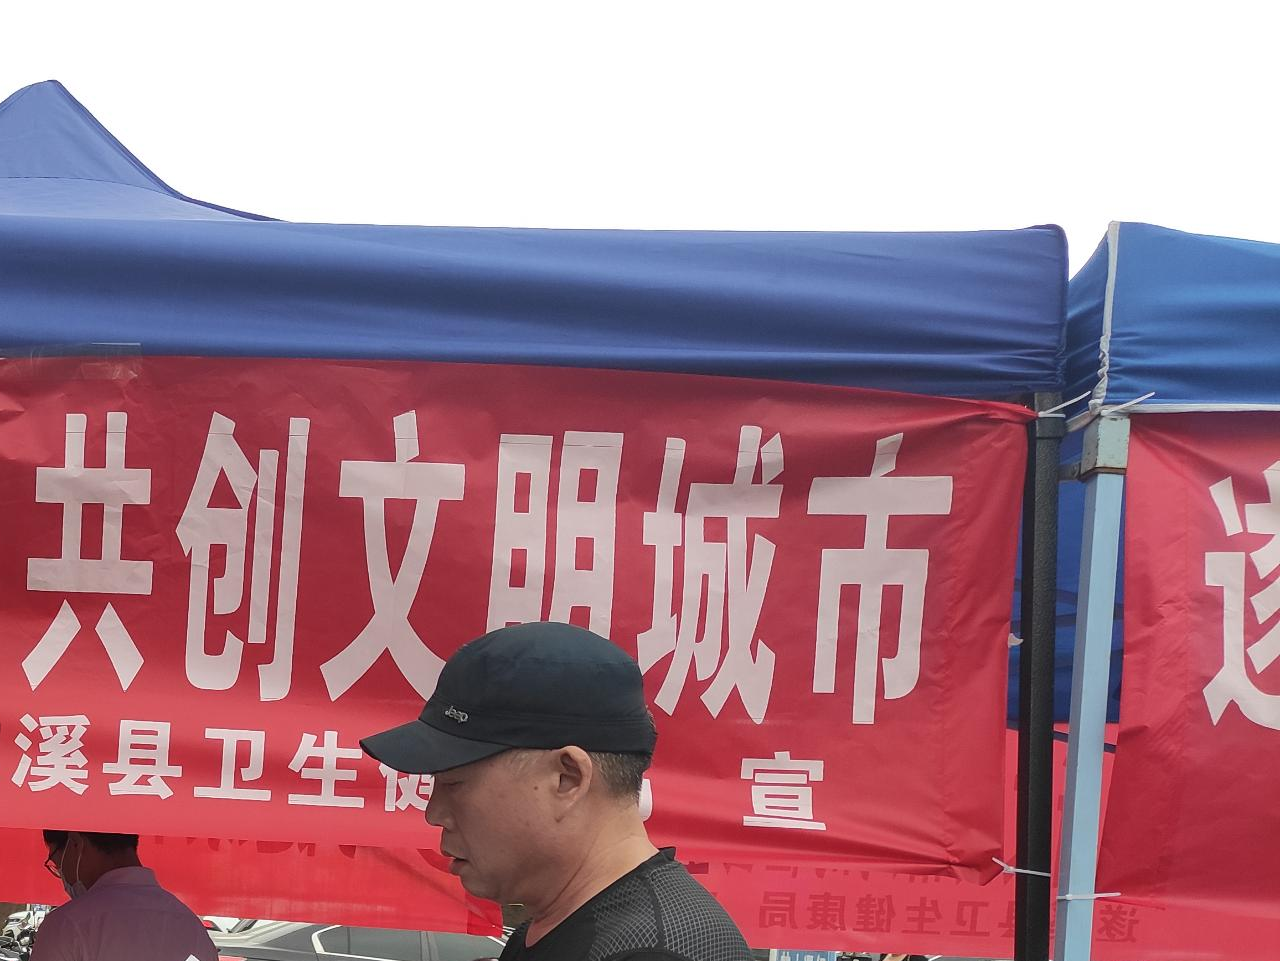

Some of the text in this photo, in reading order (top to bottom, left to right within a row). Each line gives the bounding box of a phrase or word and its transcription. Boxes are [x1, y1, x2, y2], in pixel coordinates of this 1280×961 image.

[21, 410, 954, 726] 共创文明城市
[740, 751, 827, 832] 宣
